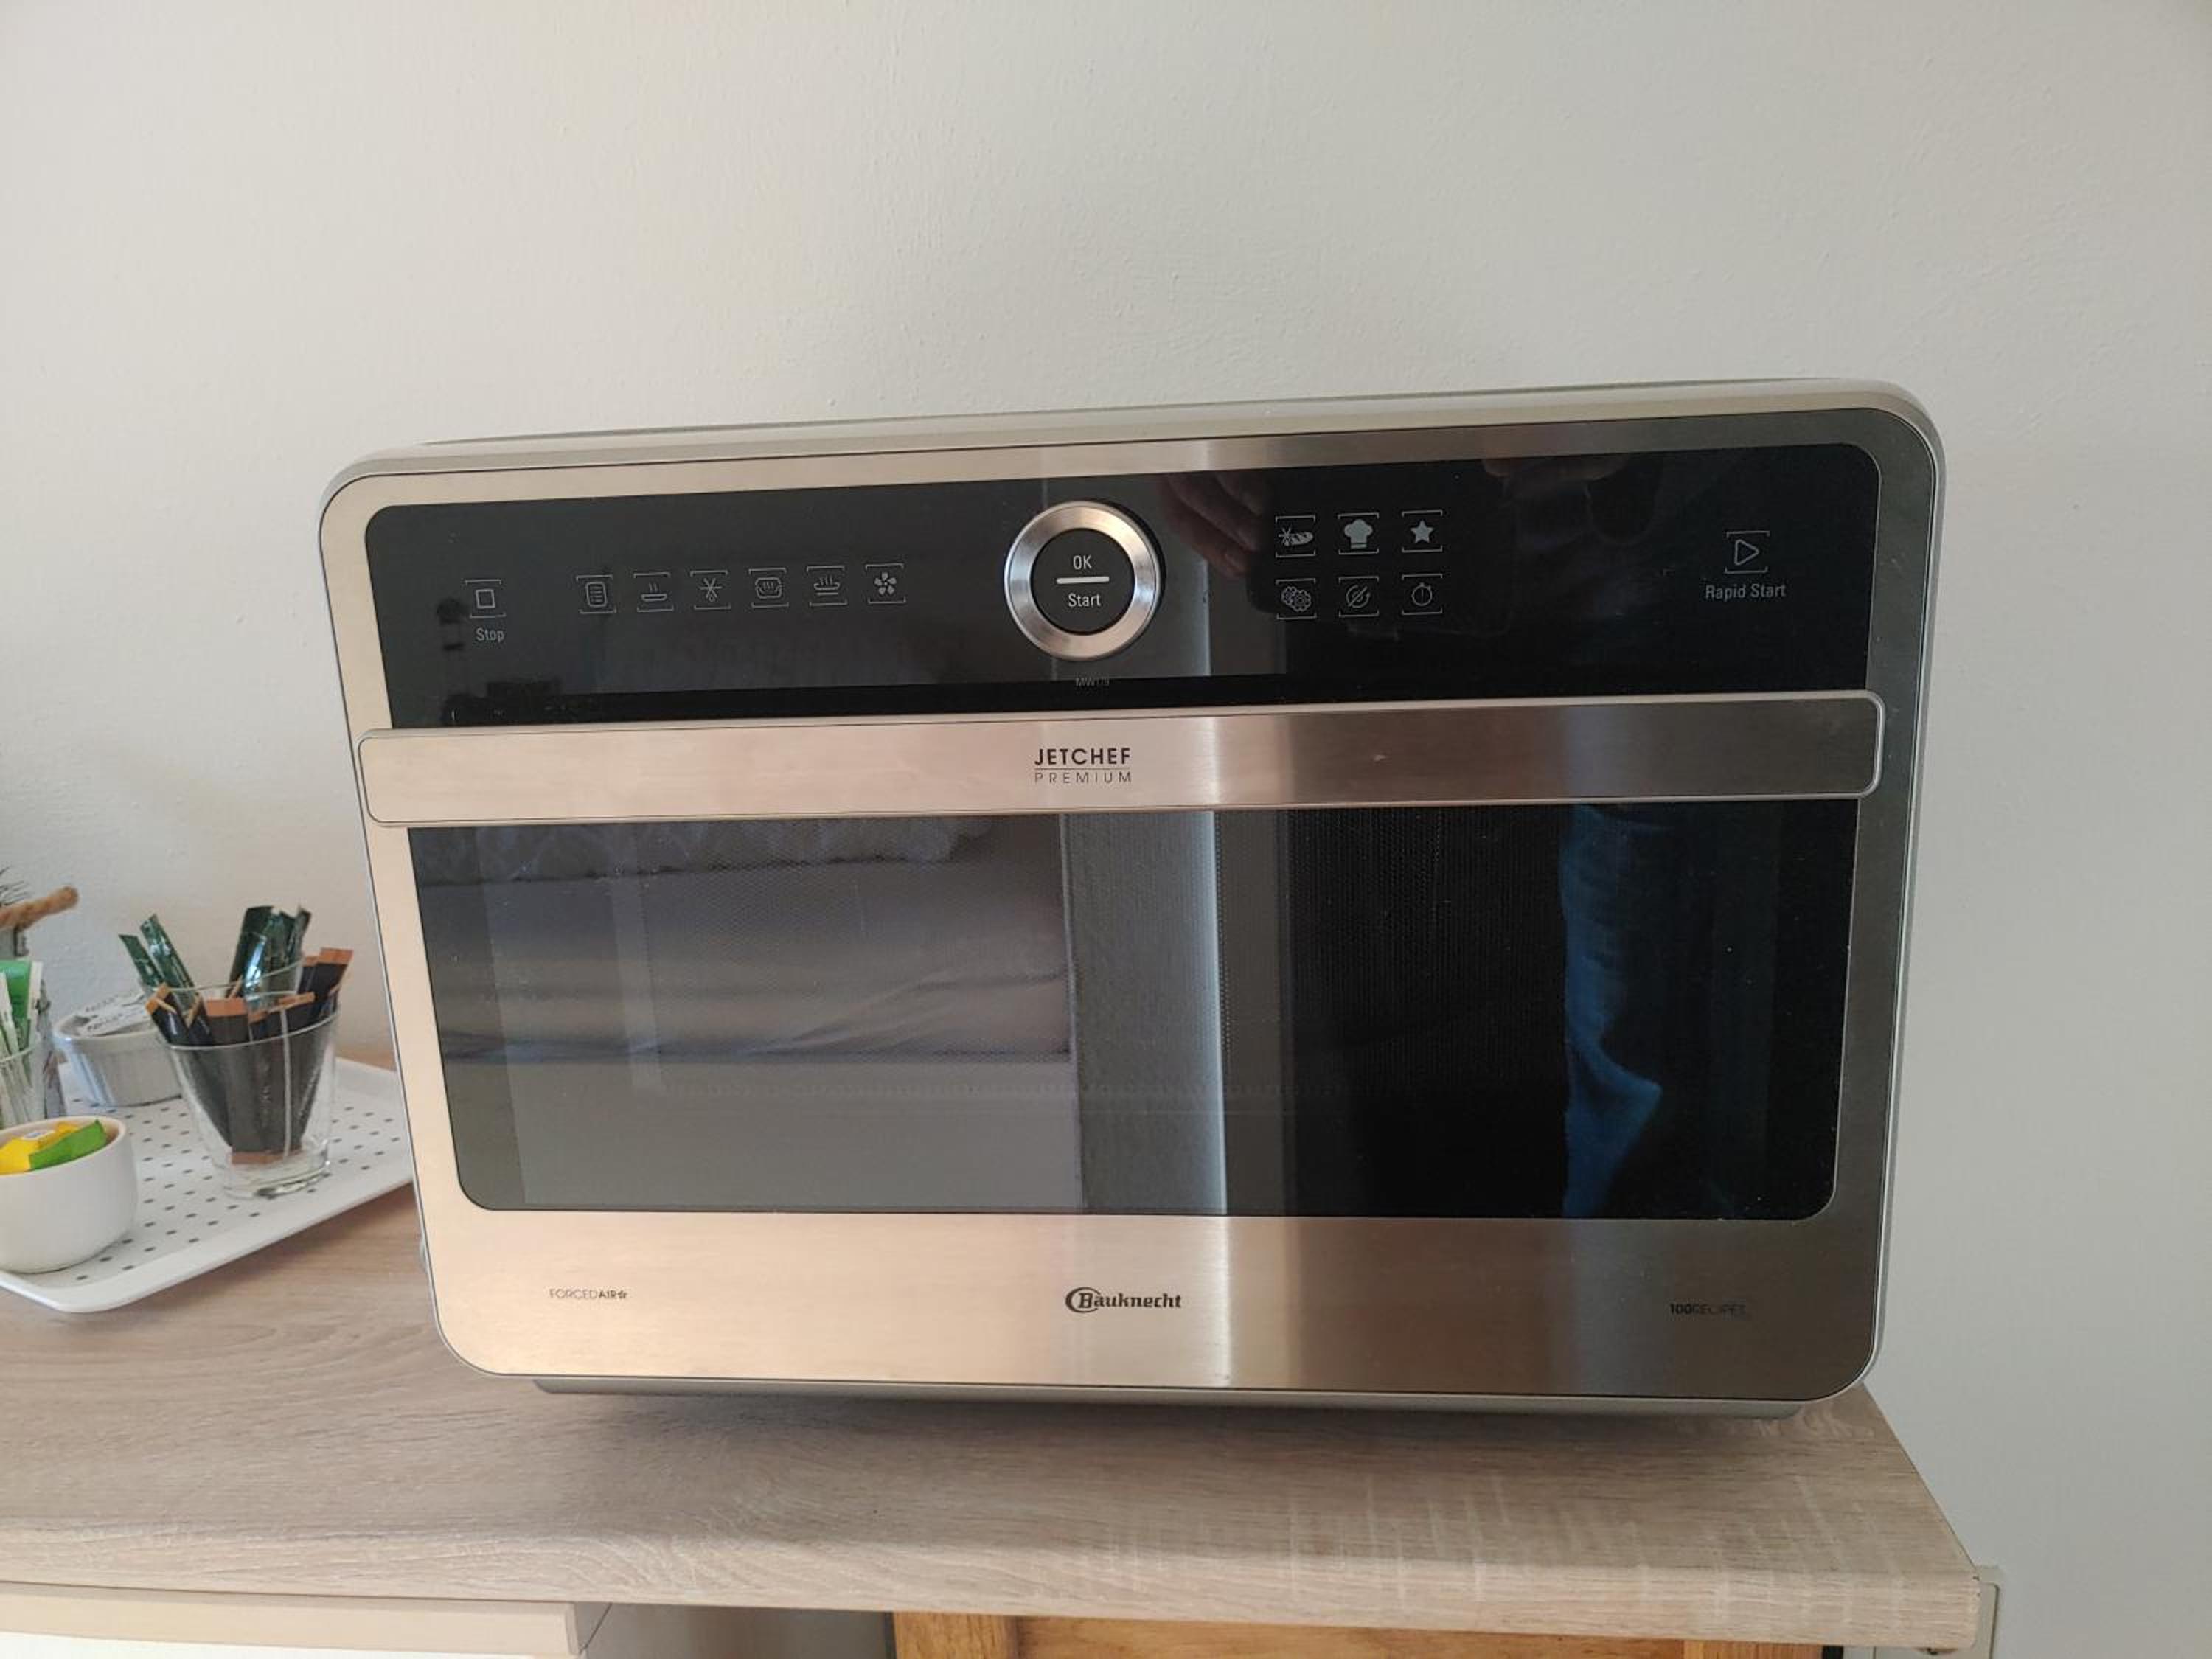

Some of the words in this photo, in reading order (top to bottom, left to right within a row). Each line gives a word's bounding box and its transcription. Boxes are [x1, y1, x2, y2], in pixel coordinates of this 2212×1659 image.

[1072, 554, 1092, 570] OK
[1705, 582, 1746, 601] Rapid
[1750, 582, 1787, 598] Start
[1068, 592, 1101, 608] Start
[476, 627, 505, 644] Stop
[1034, 747, 1130, 765] JETCHEF
[1034, 771, 1131, 784] PREMIUM
[549, 1289, 617, 1300] FORCEDAIR
[1067, 1289, 1181, 1312] Bauknecht
